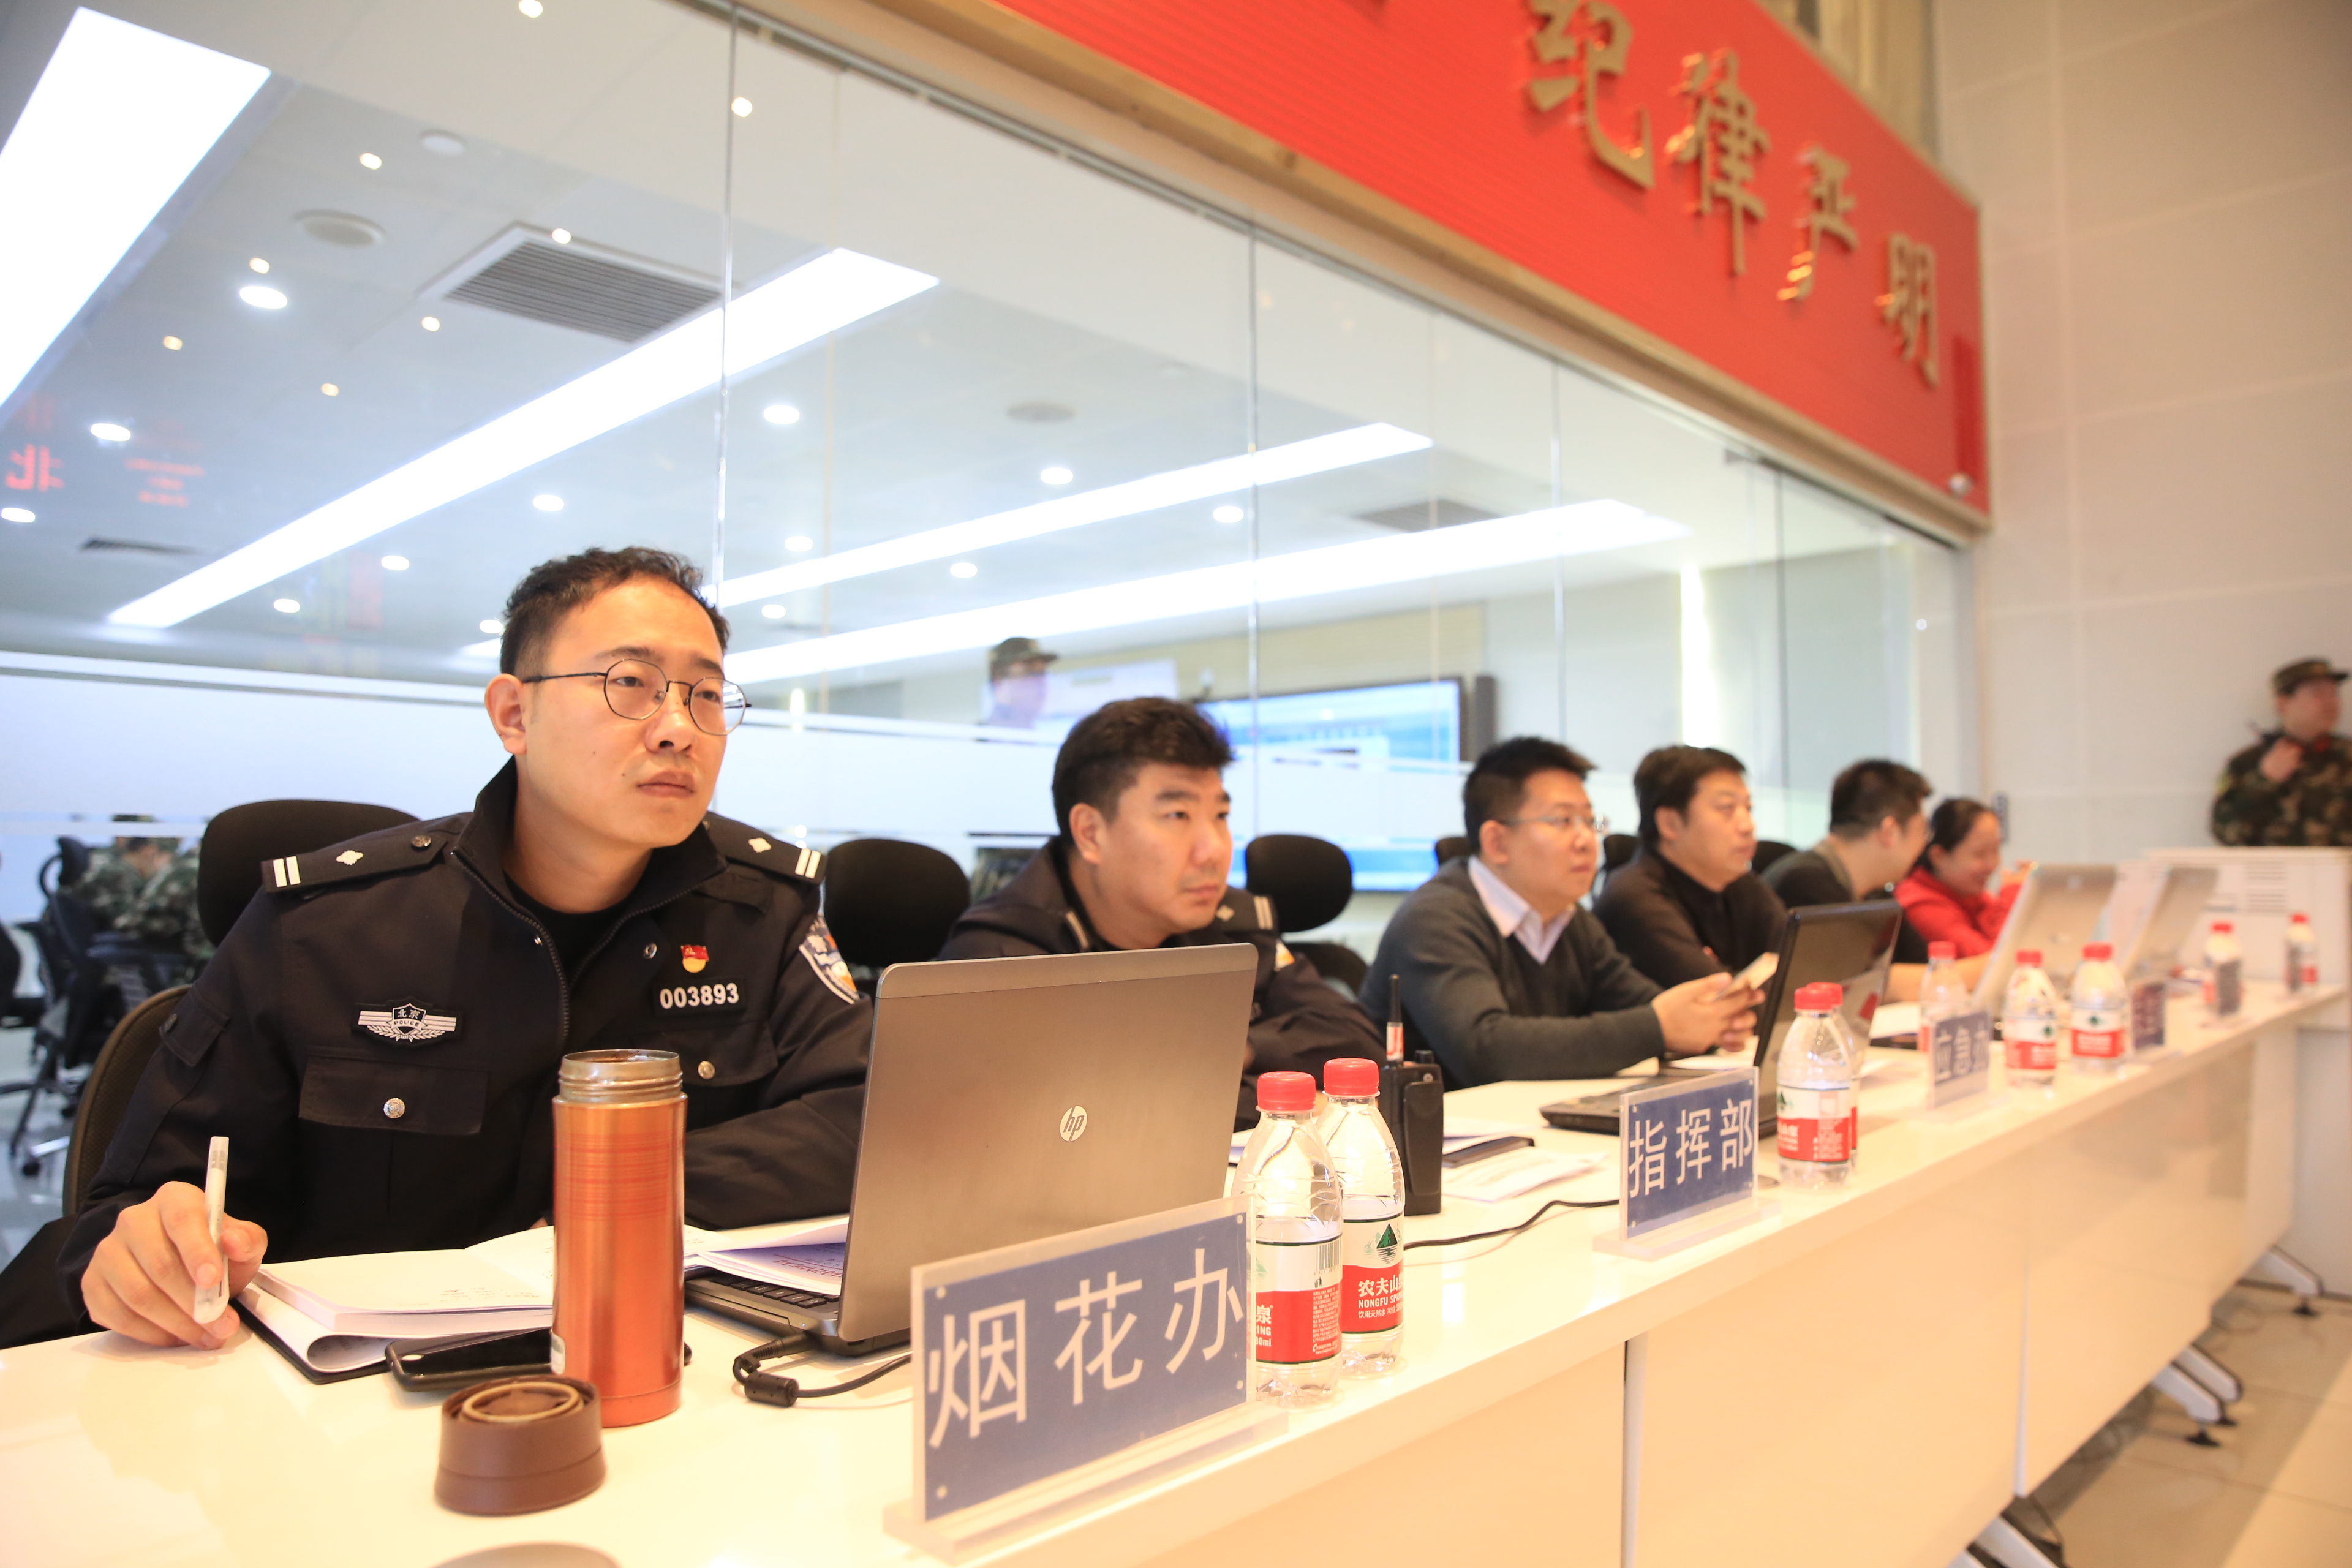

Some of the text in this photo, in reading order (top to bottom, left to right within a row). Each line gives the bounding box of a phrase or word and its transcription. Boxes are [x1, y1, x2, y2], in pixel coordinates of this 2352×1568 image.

[1523, 0, 1938, 389] 纪律严明
[659, 982, 739, 1009] 003893
[397, 1008, 421, 1019] 北京
[1061, 1105, 1085, 1142] hp
[1628, 1098, 1754, 1199] 指挥部
[1358, 1290, 1403, 1308] NONGFU SPR
[1358, 1308, 1386, 1319] 饮用天然水
[1256, 1325, 1272, 1336] ING
[928, 1248, 1245, 1449] 烟花办
